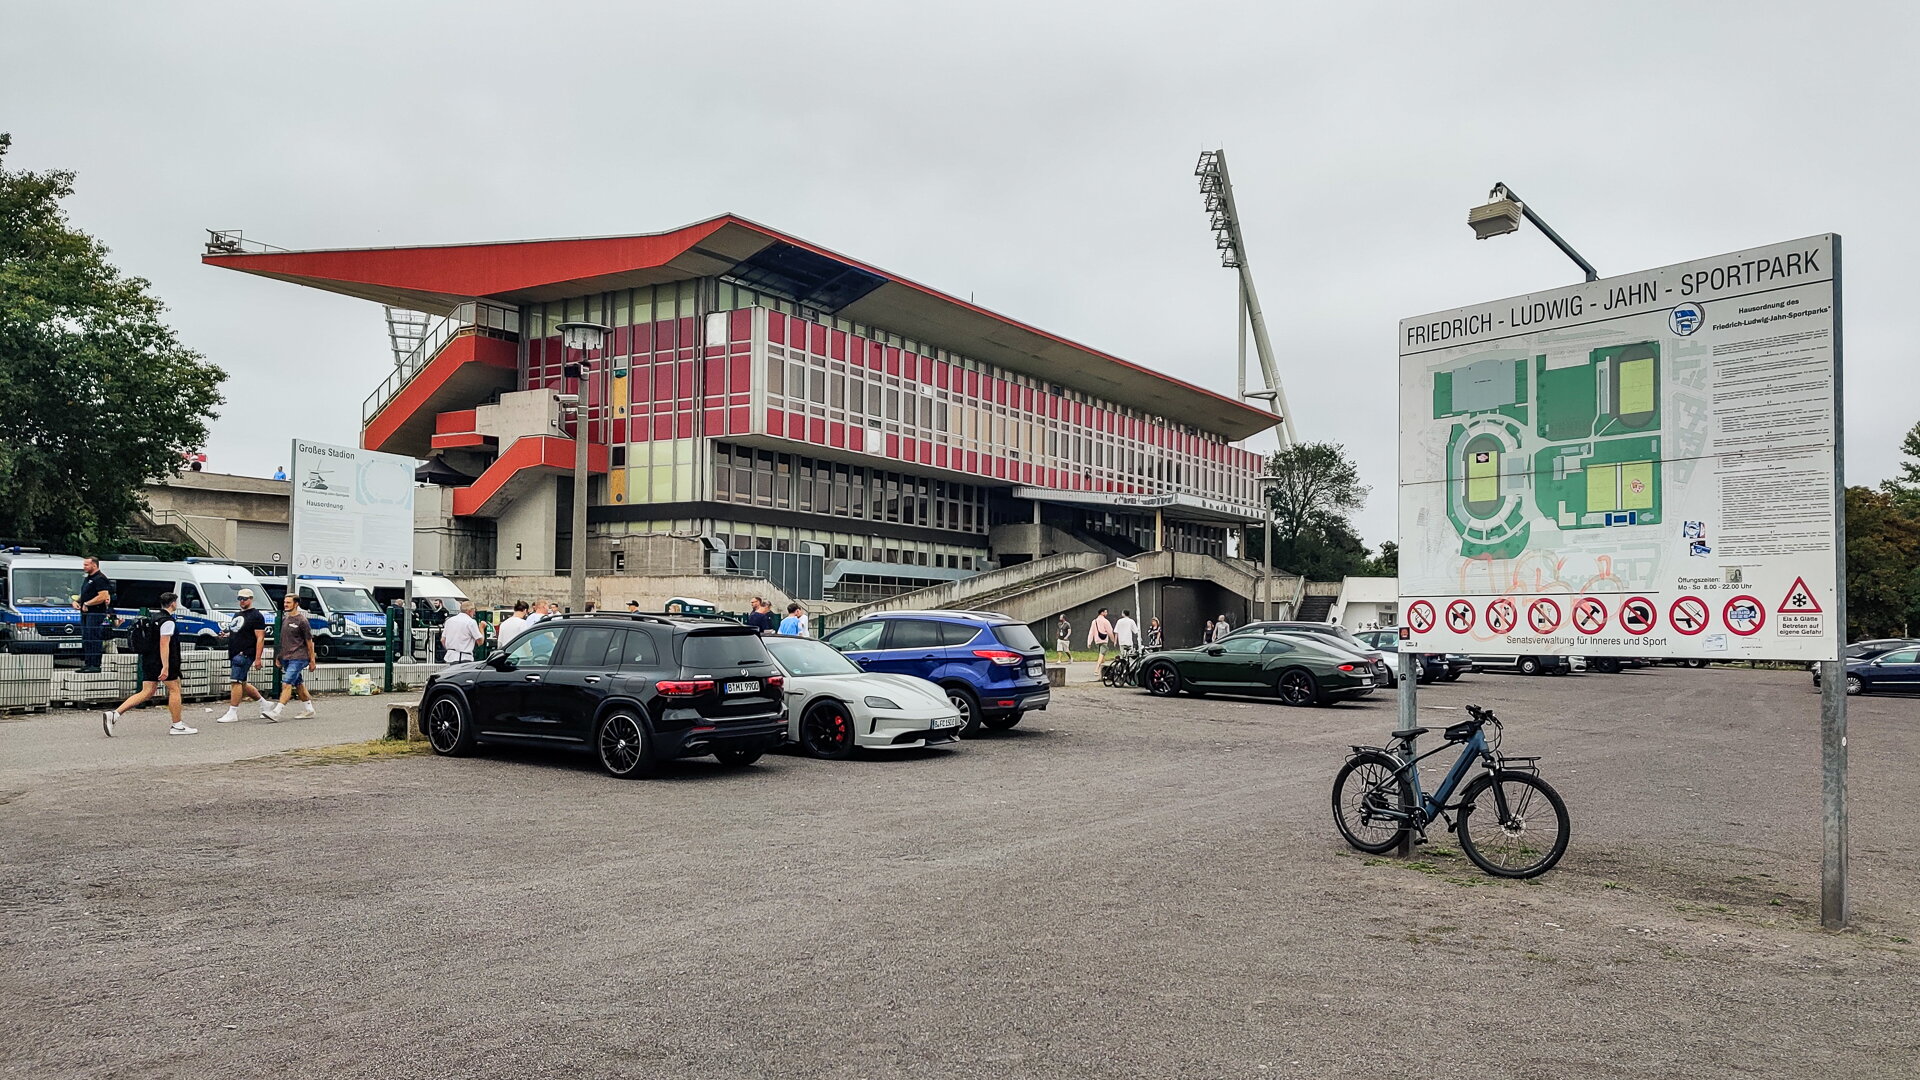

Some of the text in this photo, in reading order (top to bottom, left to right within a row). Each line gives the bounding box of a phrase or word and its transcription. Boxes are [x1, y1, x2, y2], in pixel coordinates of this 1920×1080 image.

[1407, 312, 1492, 346] FRIEDRICH
[1511, 295, 1583, 328] LUDWIG
[1603, 280, 1658, 311] JAHN
[1681, 248, 1820, 296] SPORTPARK
[1738, 300, 1786, 314] Hausordnung
[298, 443, 355, 460] Großes Stadion
[306, 499, 344, 511] Hausordnung
[1506, 635, 1667, 648] Senatsverwaltung für Inneres und Sport
